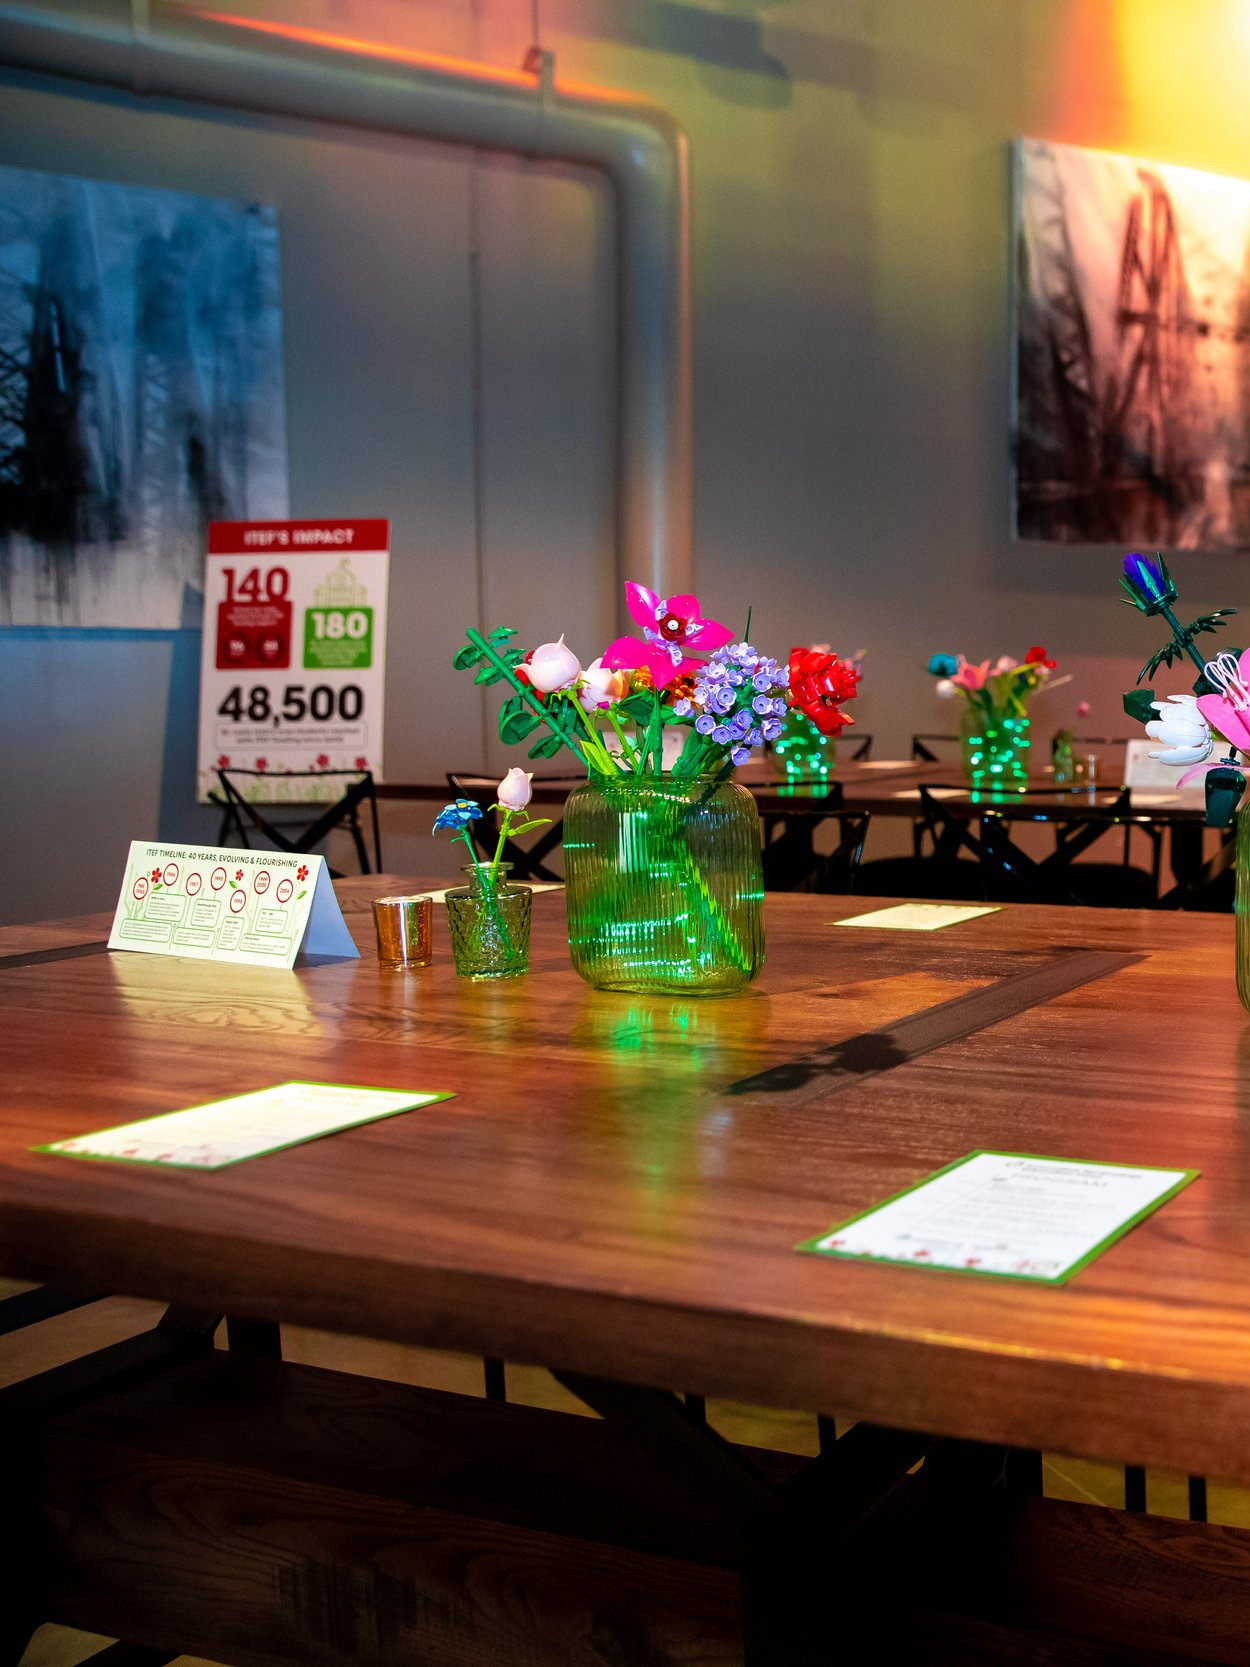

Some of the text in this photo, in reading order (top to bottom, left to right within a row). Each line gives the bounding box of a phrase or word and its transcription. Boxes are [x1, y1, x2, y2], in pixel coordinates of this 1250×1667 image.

[243, 528, 354, 545] ITEF'S IMPACT
[222, 566, 289, 602] 140
[312, 611, 368, 639] 180
[218, 684, 364, 727] 48,500
[146, 848, 158, 857] ITEF
[159, 850, 187, 859] TIMELINE:
[188, 852, 197, 860] 40
[218, 855, 249, 864] EVOLVING
[256, 857, 298, 868] FLOURISHING
